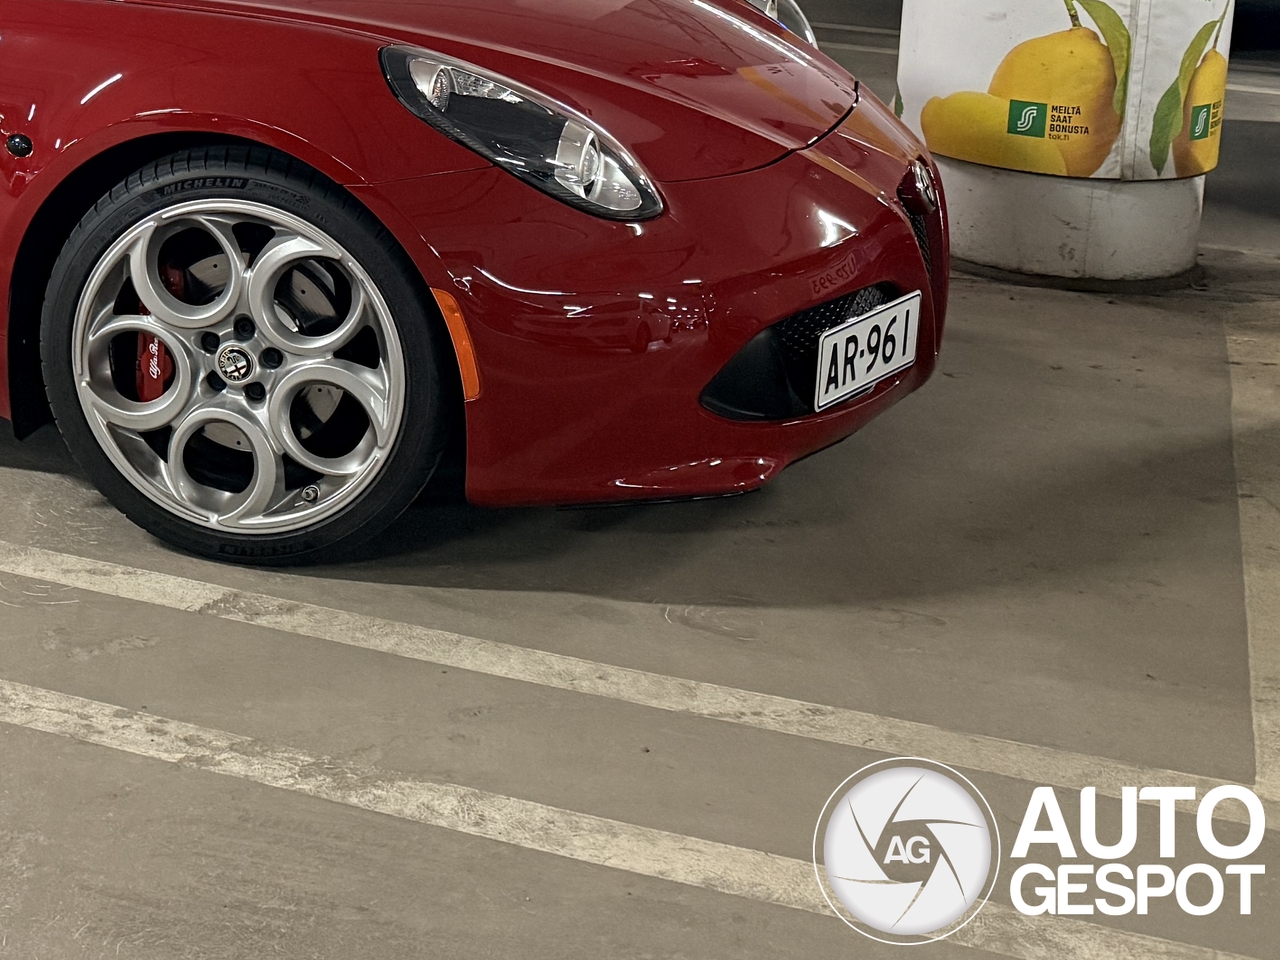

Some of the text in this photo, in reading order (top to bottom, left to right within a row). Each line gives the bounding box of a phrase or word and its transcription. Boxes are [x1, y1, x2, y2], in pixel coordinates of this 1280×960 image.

[1051, 105, 1081, 115] MEILTÄ
[1050, 114, 1073, 124] SAAT
[1049, 123, 1089, 135] BONUSTA
[163, 178, 244, 195] MICHELIN
[824, 308, 910, 395] AR-961
